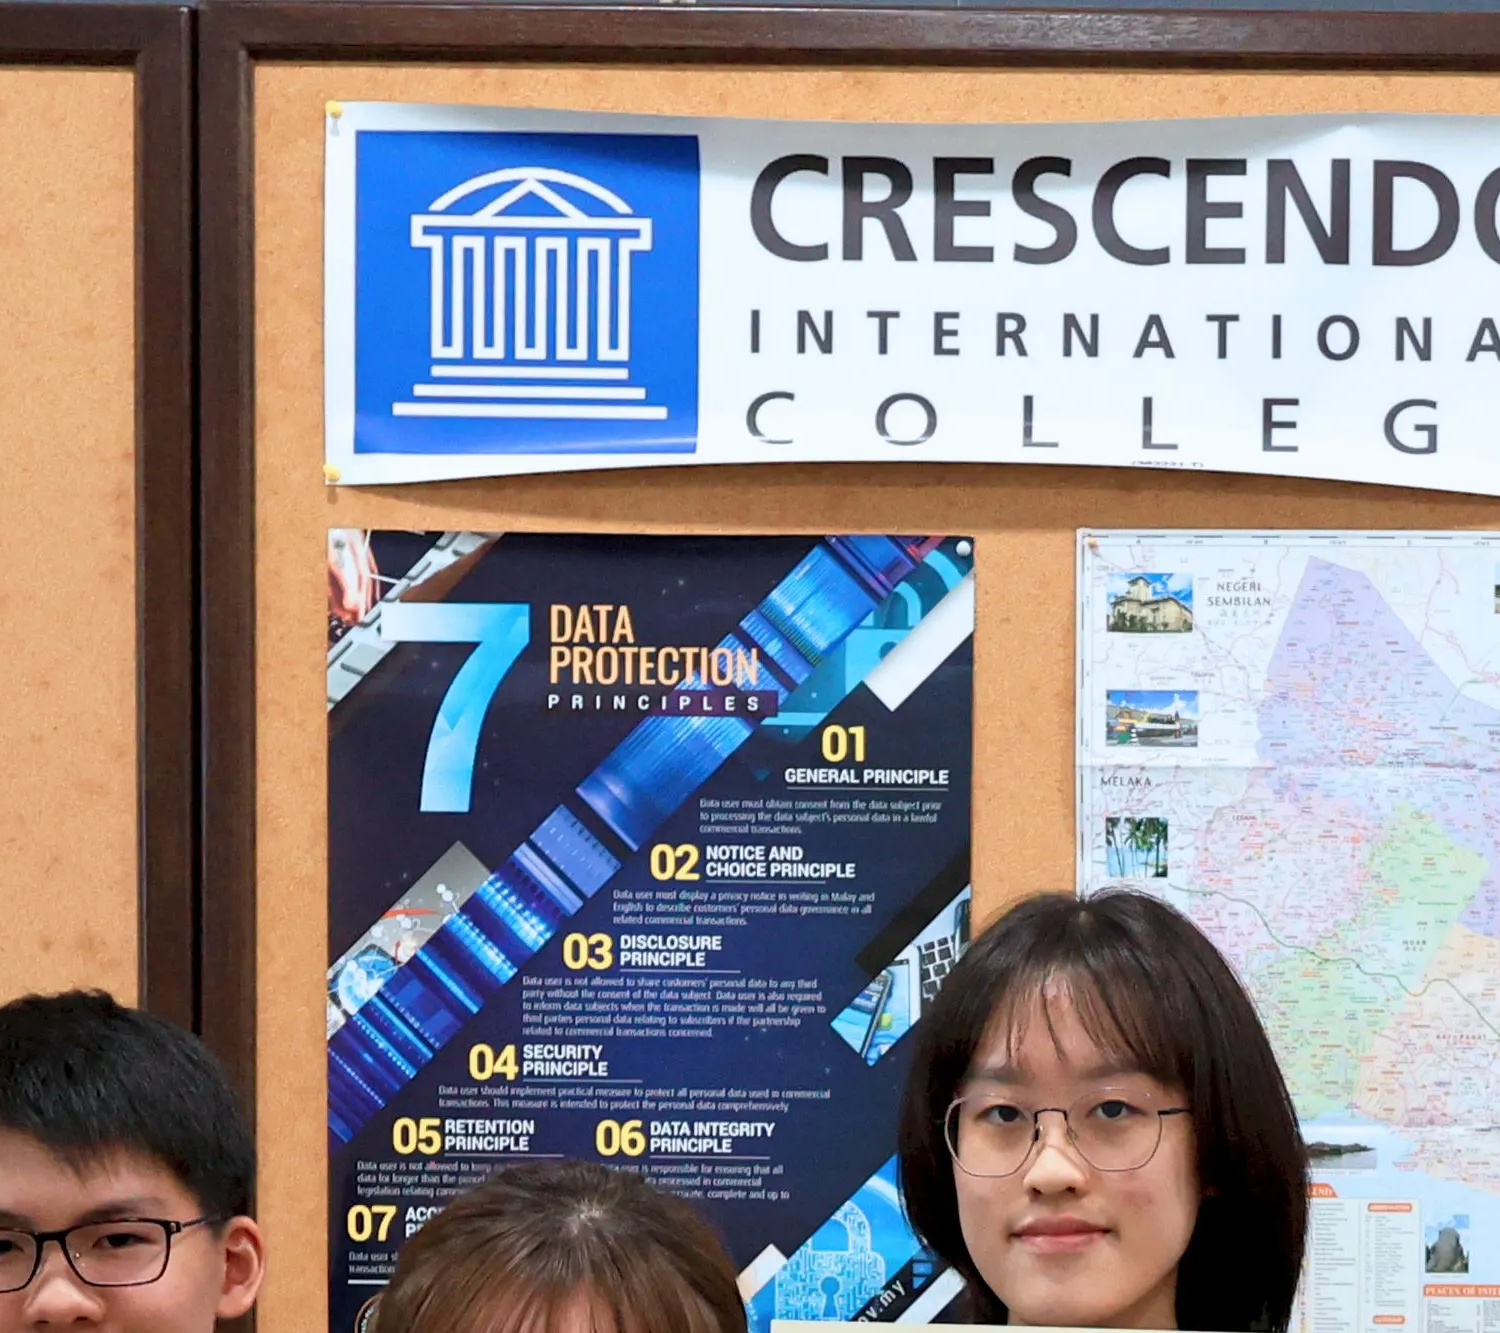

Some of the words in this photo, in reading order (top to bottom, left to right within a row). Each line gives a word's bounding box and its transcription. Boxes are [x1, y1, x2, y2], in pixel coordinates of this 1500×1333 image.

[1207, 596, 1271, 607] SEMBILAN
[550, 605, 635, 644] DATA
[550, 646, 760, 687] PROTECTION
[381, 602, 530, 813] 7
[547, 694, 761, 712] PRINCIPLES
[821, 725, 866, 763] 01
[785, 768, 860, 785] GENERAL
[863, 768, 950, 786] PRINCIPLE
[1100, 775, 1153, 788] MELAKA
[650, 843, 700, 882] 02
[706, 845, 765, 863] NOTICE
[768, 845, 804, 863] AND
[705, 861, 767, 879] CHOICE
[770, 862, 856, 880] PRINCIPLE
[562, 933, 613, 970] 03
[620, 935, 723, 952] DISCLOSURE
[620, 951, 707, 969] PRINCIPLE
[468, 1043, 519, 1081] 04
[522, 1044, 604, 1062] SECURITY
[522, 1060, 609, 1078] PRINCIPLE
[391, 1117, 441, 1155] 05
[444, 1118, 535, 1136] RETENTION
[444, 1135, 530, 1152] PRINCIPLE
[595, 1120, 645, 1157] 06
[650, 1121, 691, 1139] DATA
[693, 1121, 776, 1140] INTEGRITY
[650, 1137, 734, 1155] PRINCIPLE
[346, 1205, 396, 1242] 07
[1425, 1286, 1460, 1296] PLACES
